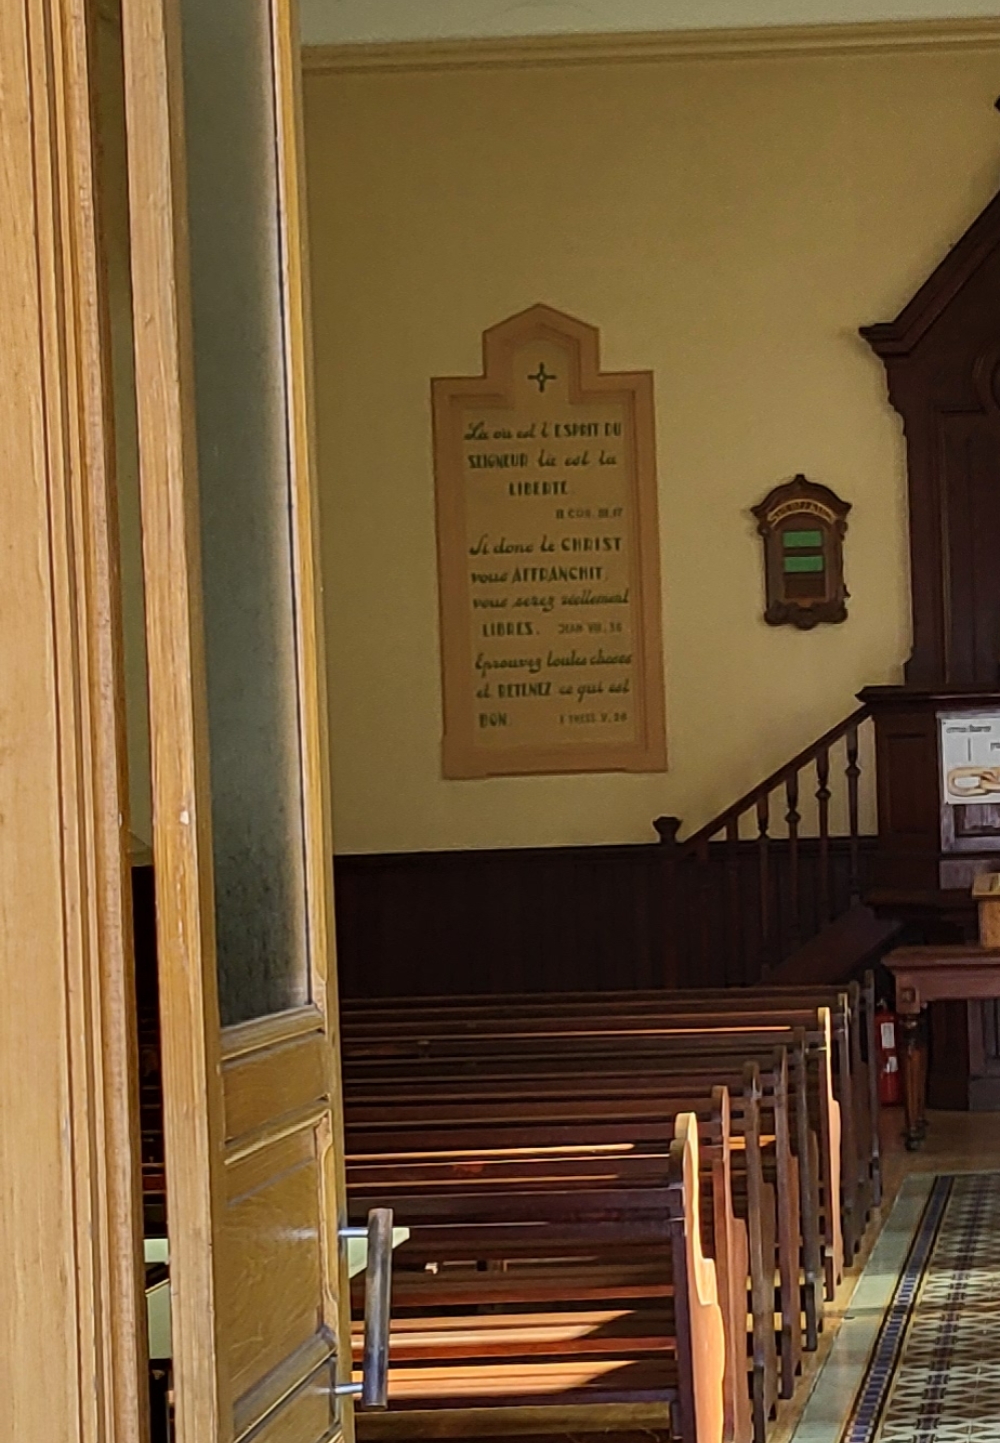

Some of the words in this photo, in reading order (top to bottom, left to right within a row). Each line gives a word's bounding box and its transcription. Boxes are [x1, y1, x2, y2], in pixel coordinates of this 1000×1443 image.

[604, 422, 622, 438] DU
[468, 453, 528, 469] SEIGNEUR
[564, 450, 590, 467] est
[493, 536, 534, 554] donc
[541, 534, 555, 553] le
[561, 537, 621, 552] CHRIST
[471, 571, 508, 584] vous
[473, 598, 508, 609] vous
[547, 650, 587, 667] toutes
[498, 681, 552, 698] RETENEZ
